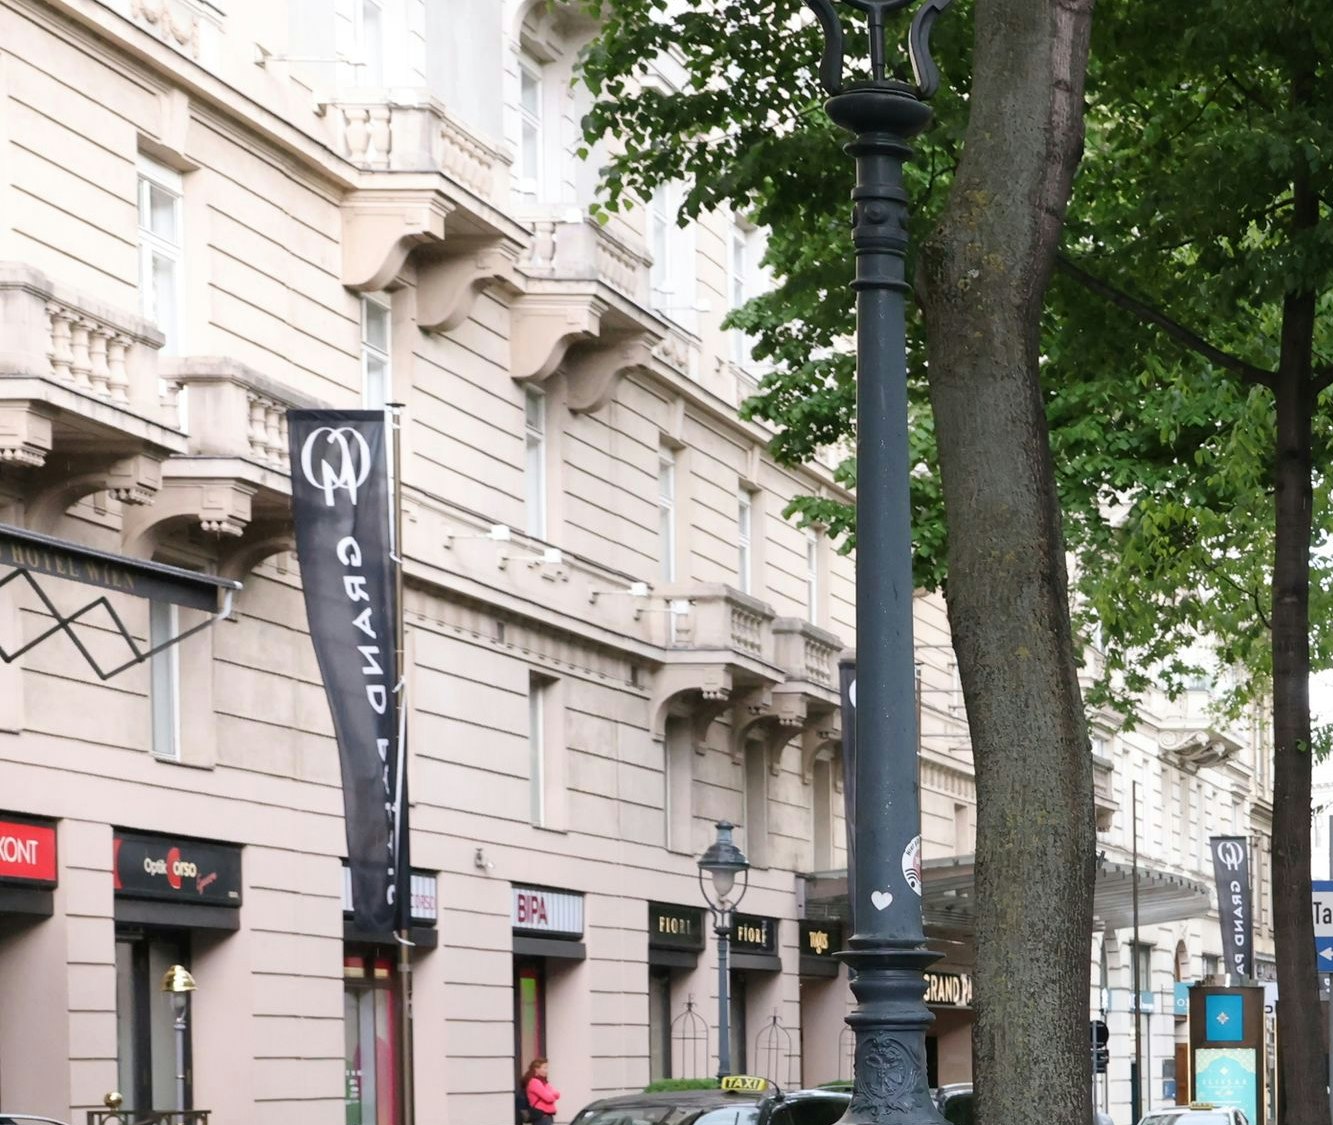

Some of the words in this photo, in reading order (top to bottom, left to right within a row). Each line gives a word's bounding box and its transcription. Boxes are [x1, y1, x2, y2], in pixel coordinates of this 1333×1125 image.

[12, 545, 79, 577] HOTEL
[518, 894, 548, 925] BIPA
[923, 975, 960, 1003] GRAND
[726, 1078, 759, 1089] TAXI
